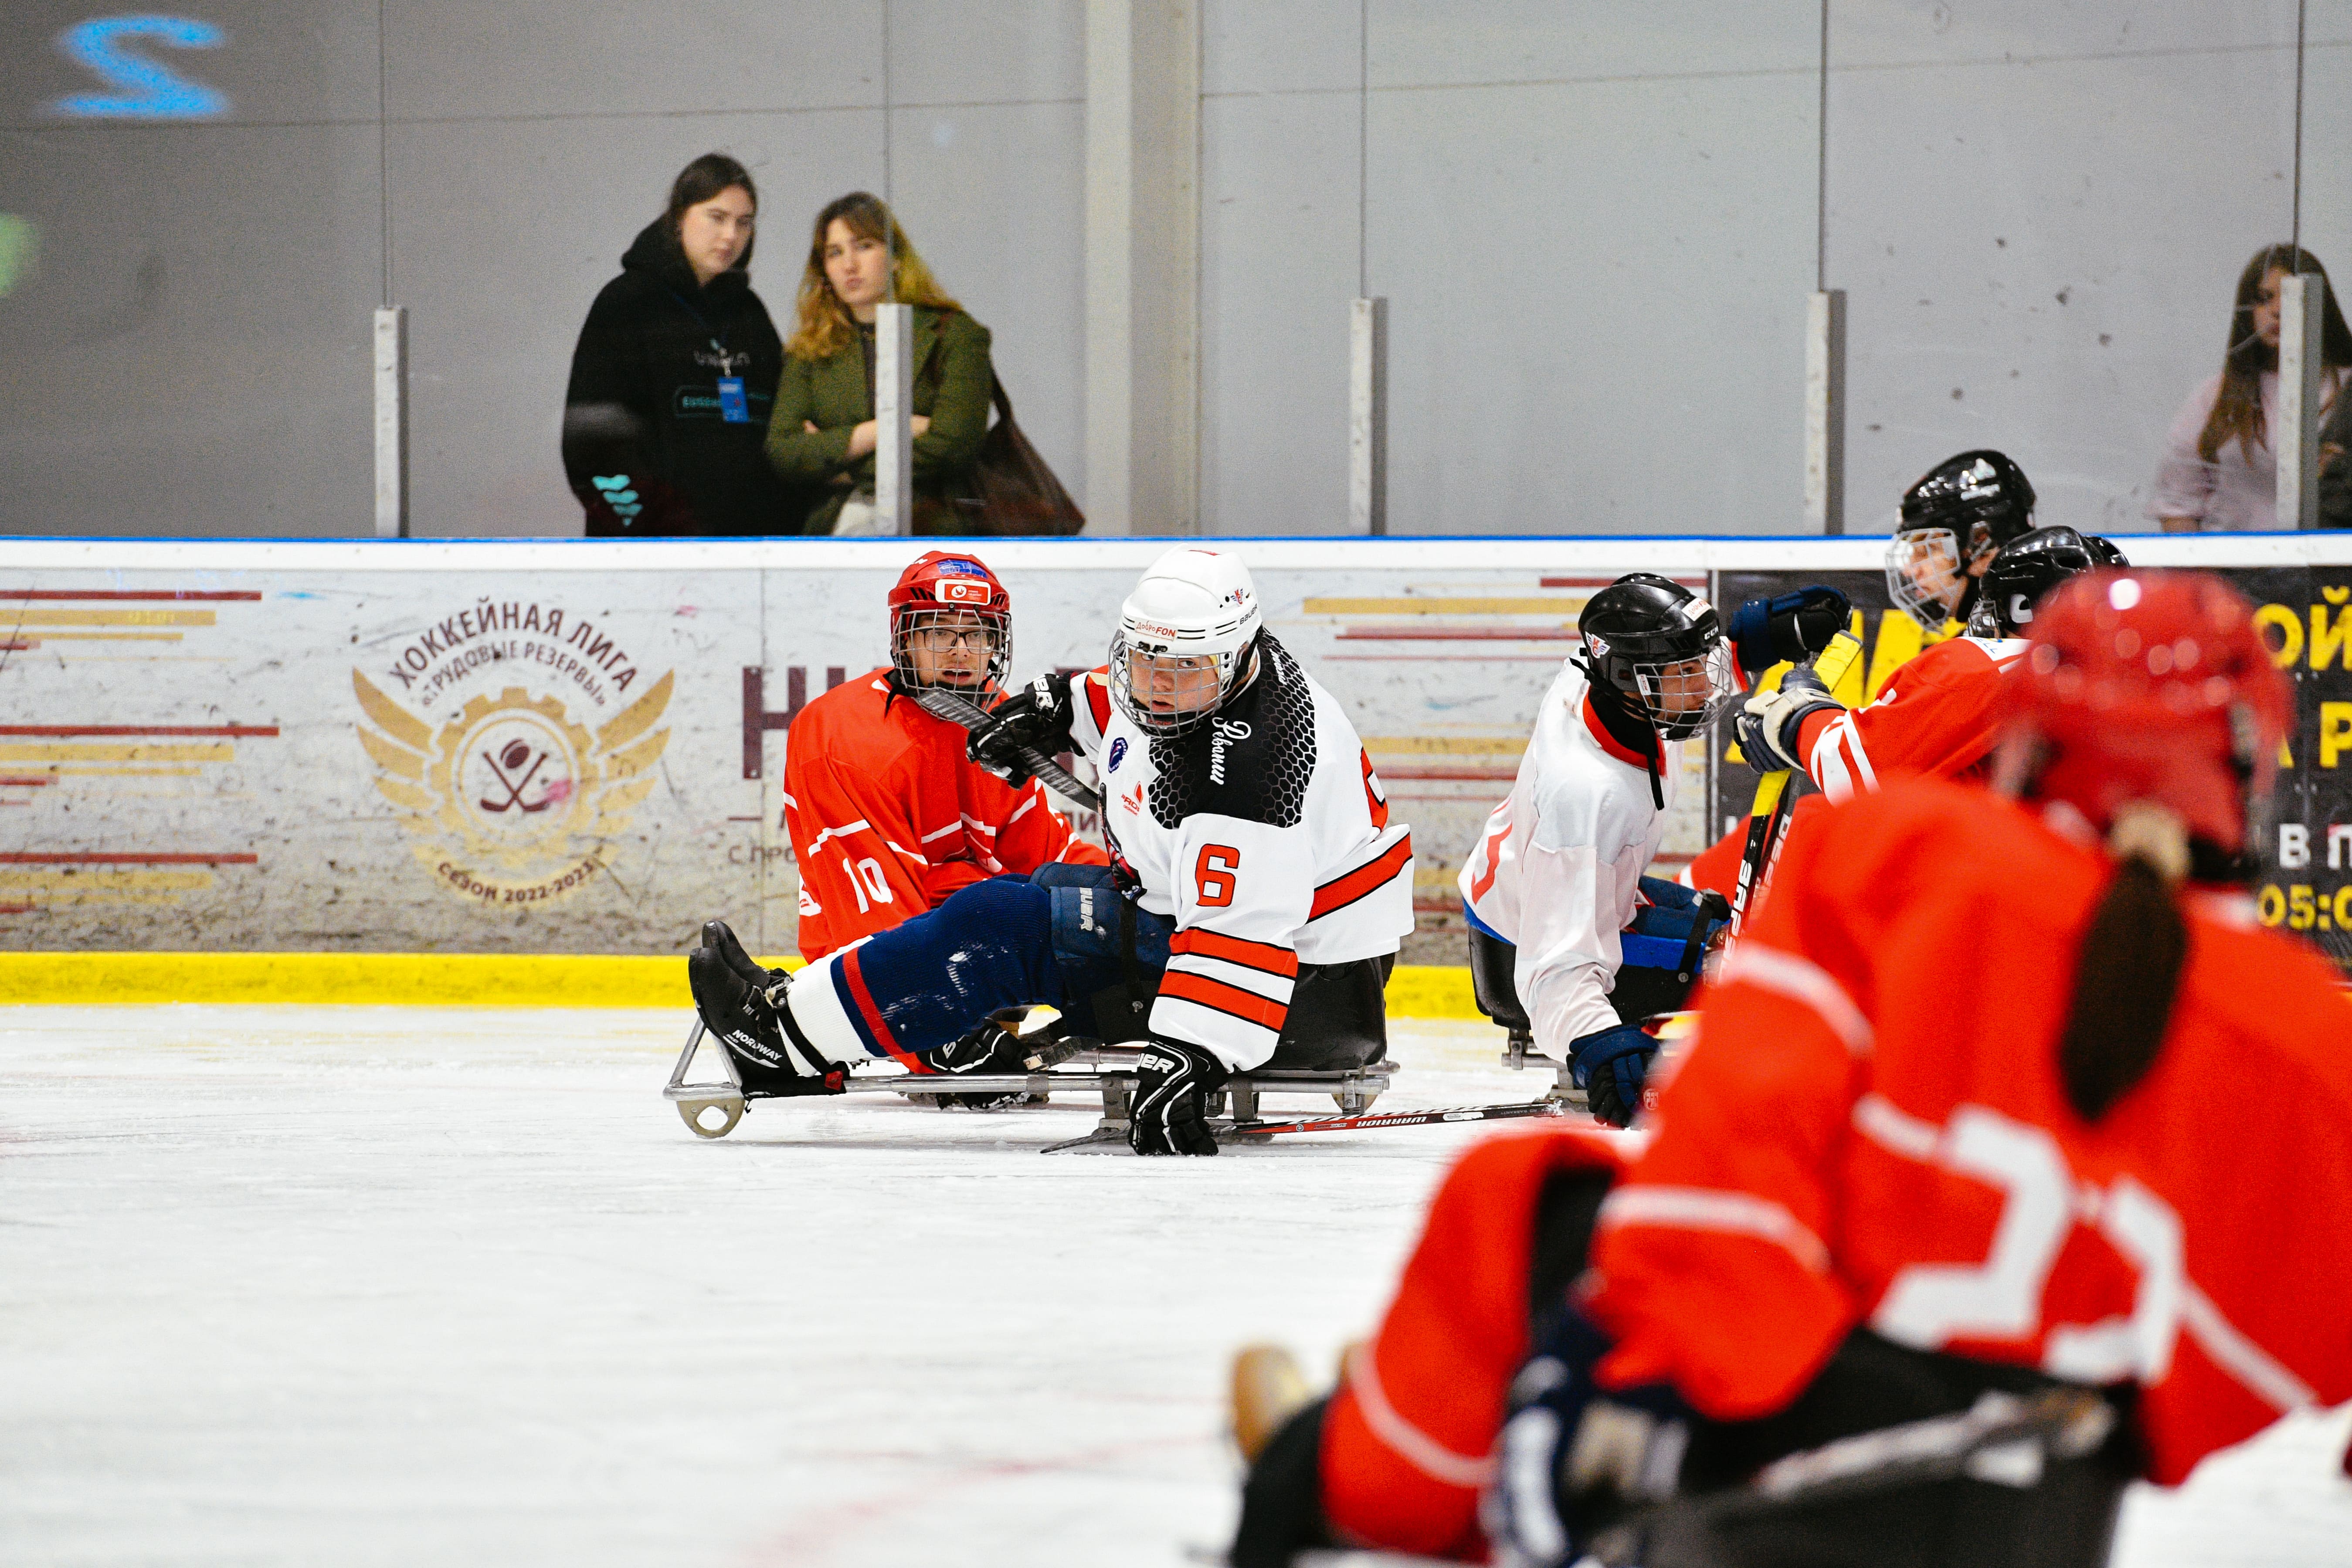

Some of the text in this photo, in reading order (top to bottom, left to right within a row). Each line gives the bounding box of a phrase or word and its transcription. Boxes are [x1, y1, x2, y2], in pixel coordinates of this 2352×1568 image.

[389, 596, 638, 692] ХОККЕЙНАЯ ЛИГА
[1704, 625, 1719, 640] CCM
[438, 859, 594, 902] СЕЗОН 2022-2023
[842, 857, 893, 914] 10
[1195, 844, 1240, 907] 6
[1723, 859, 1752, 960] ЗАРЯ
[732, 1029, 783, 1061] NORDWAY
[1356, 1116, 1427, 1127] WARRIOR
